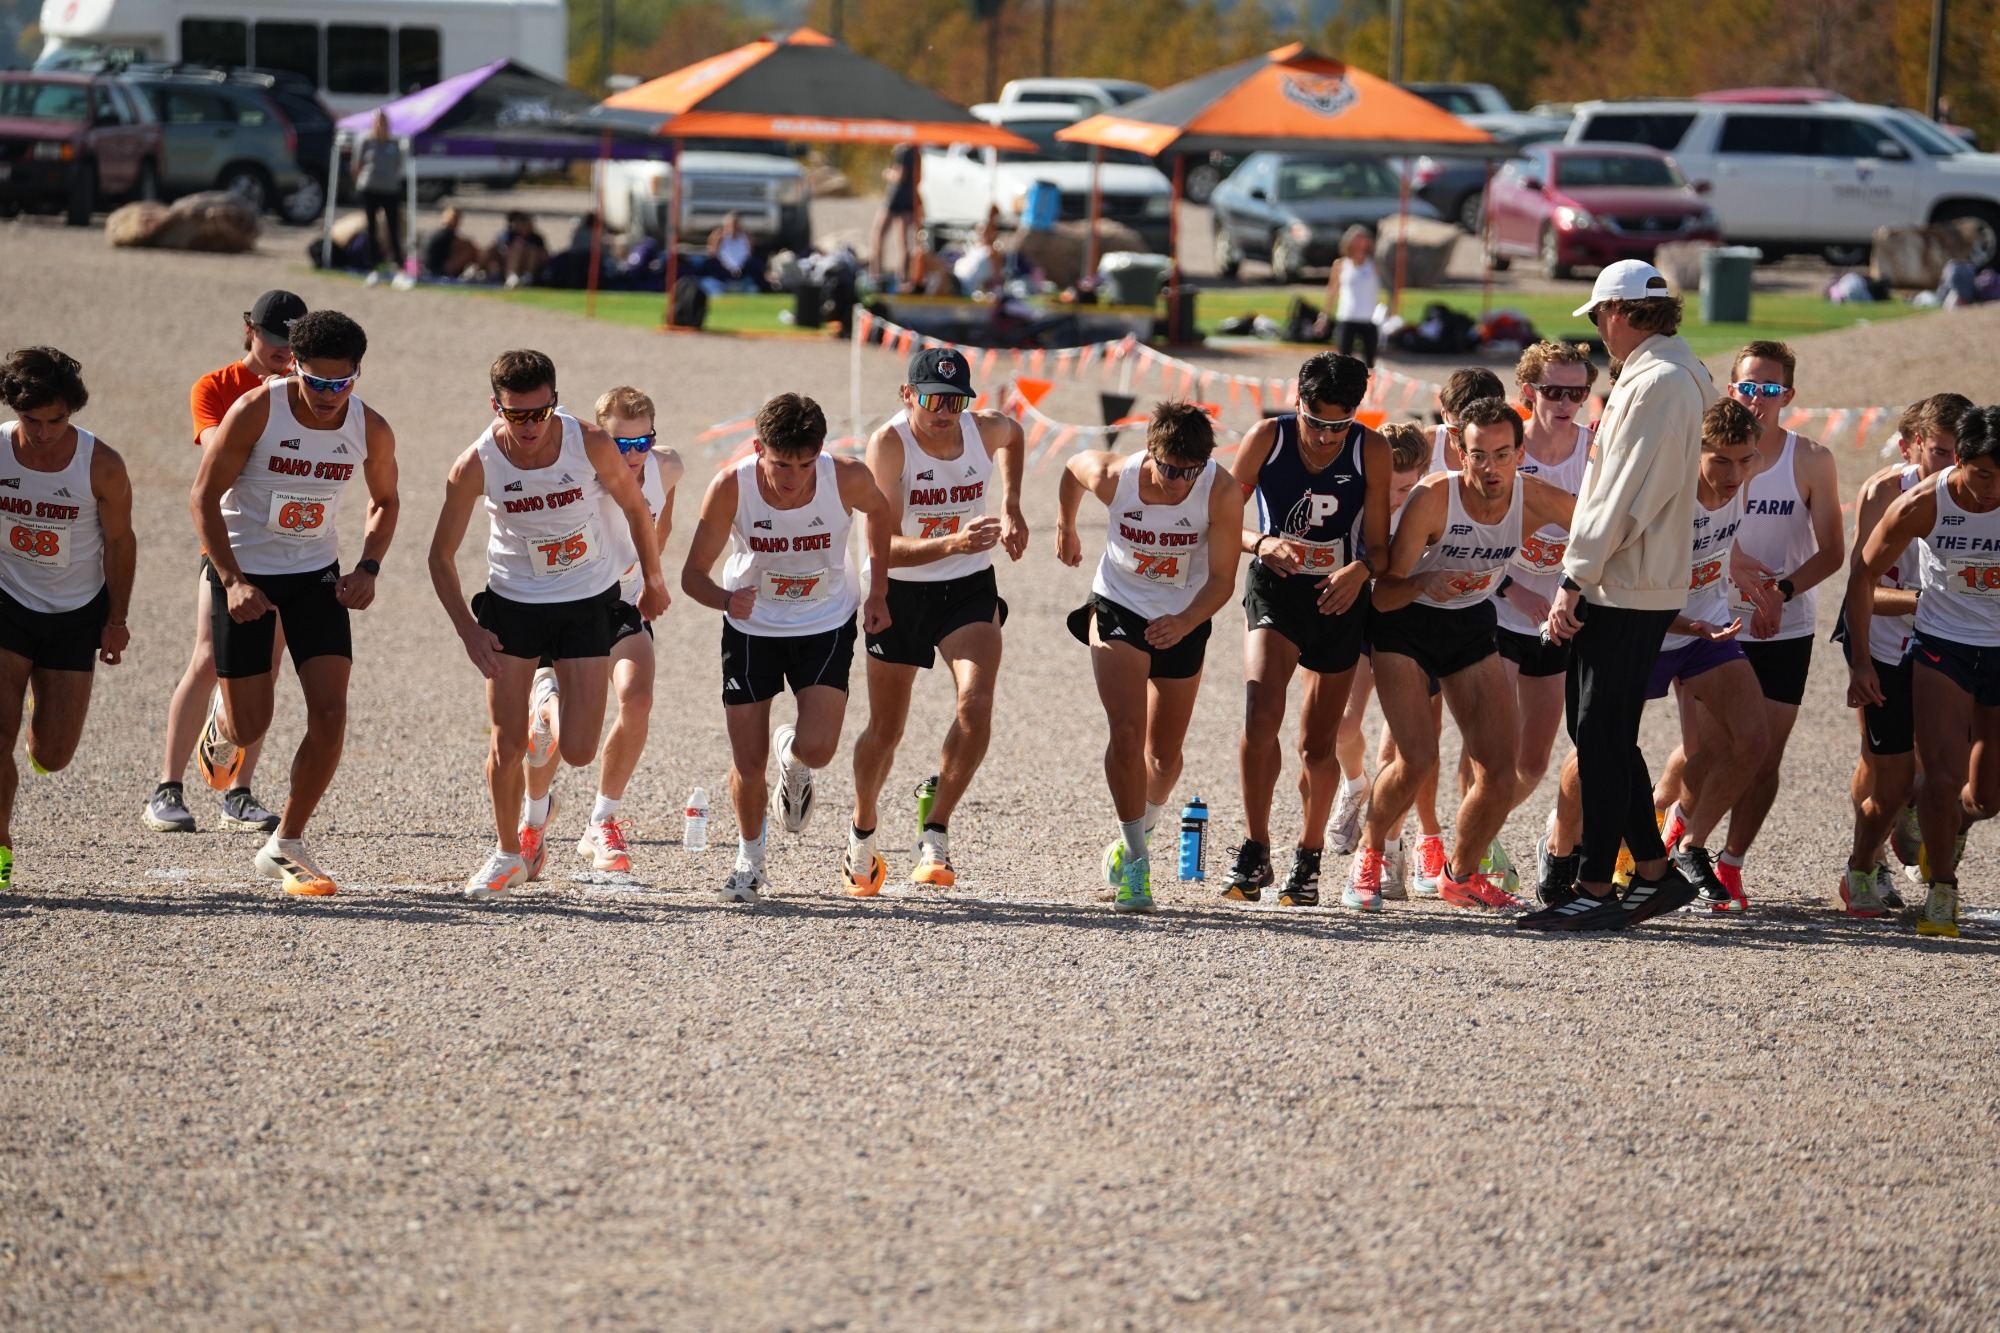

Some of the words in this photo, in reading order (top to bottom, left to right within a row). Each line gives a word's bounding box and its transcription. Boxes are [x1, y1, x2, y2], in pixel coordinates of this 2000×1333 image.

[268, 455, 311, 476] IDAHO
[314, 462, 354, 481] STATE
[503, 496, 544, 513] IDAHO
[546, 487, 583, 509] STATE
[909, 488, 947, 505] IDAHO
[950, 481, 983, 503] STATE
[36, 502, 79, 520] STATE
[279, 502, 325, 528] 63
[1309, 493, 1339, 527] P
[1745, 500, 1795, 515] FARM
[918, 515, 960, 538] 71
[1449, 524, 1472, 535] REP
[1941, 516, 1965, 526] REP
[10, 526, 59, 556] 68
[750, 536, 789, 553] IDAHO
[793, 532, 831, 552] STATE
[1120, 522, 1156, 545] IDAHO
[1159, 533, 1198, 546] STATE
[1693, 536, 1711, 551] HE
[1711, 519, 1741, 543] FAR
[1936, 536, 1967, 550] THE
[537, 533, 587, 566] 75
[1441, 545, 1470, 559] THE
[1471, 546, 1516, 560] FARM
[1520, 537, 1566, 566] 53
[1133, 552, 1179, 577] 74
[771, 577, 819, 596] 77
[1958, 566, 2000, 589] 16
